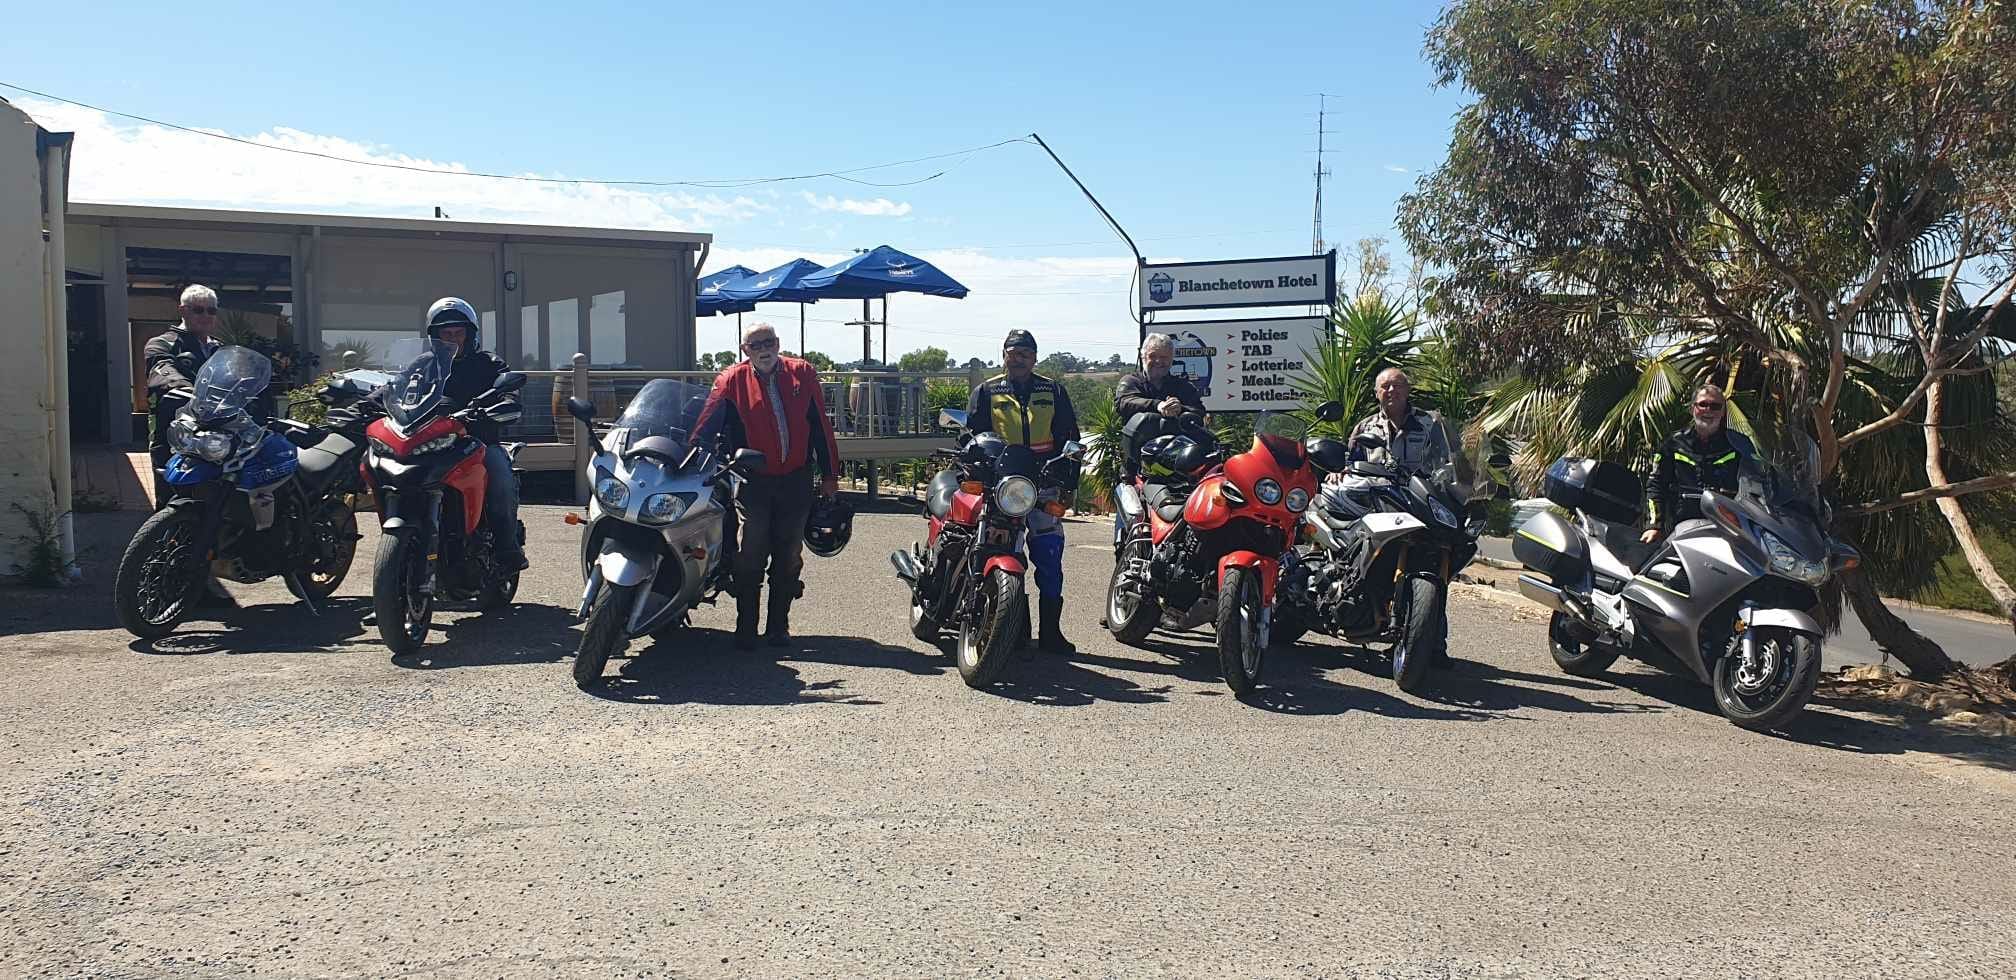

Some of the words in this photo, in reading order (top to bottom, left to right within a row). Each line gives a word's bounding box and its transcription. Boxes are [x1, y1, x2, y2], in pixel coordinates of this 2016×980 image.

[1178, 278, 1274, 293] Blanchetown
[1277, 273, 1318, 288] Hotel
[1241, 329, 1288, 341] Pokies
[1241, 345, 1273, 356] TAB
[1241, 359, 1303, 371] Lotteries
[1241, 374, 1285, 386] Meals
